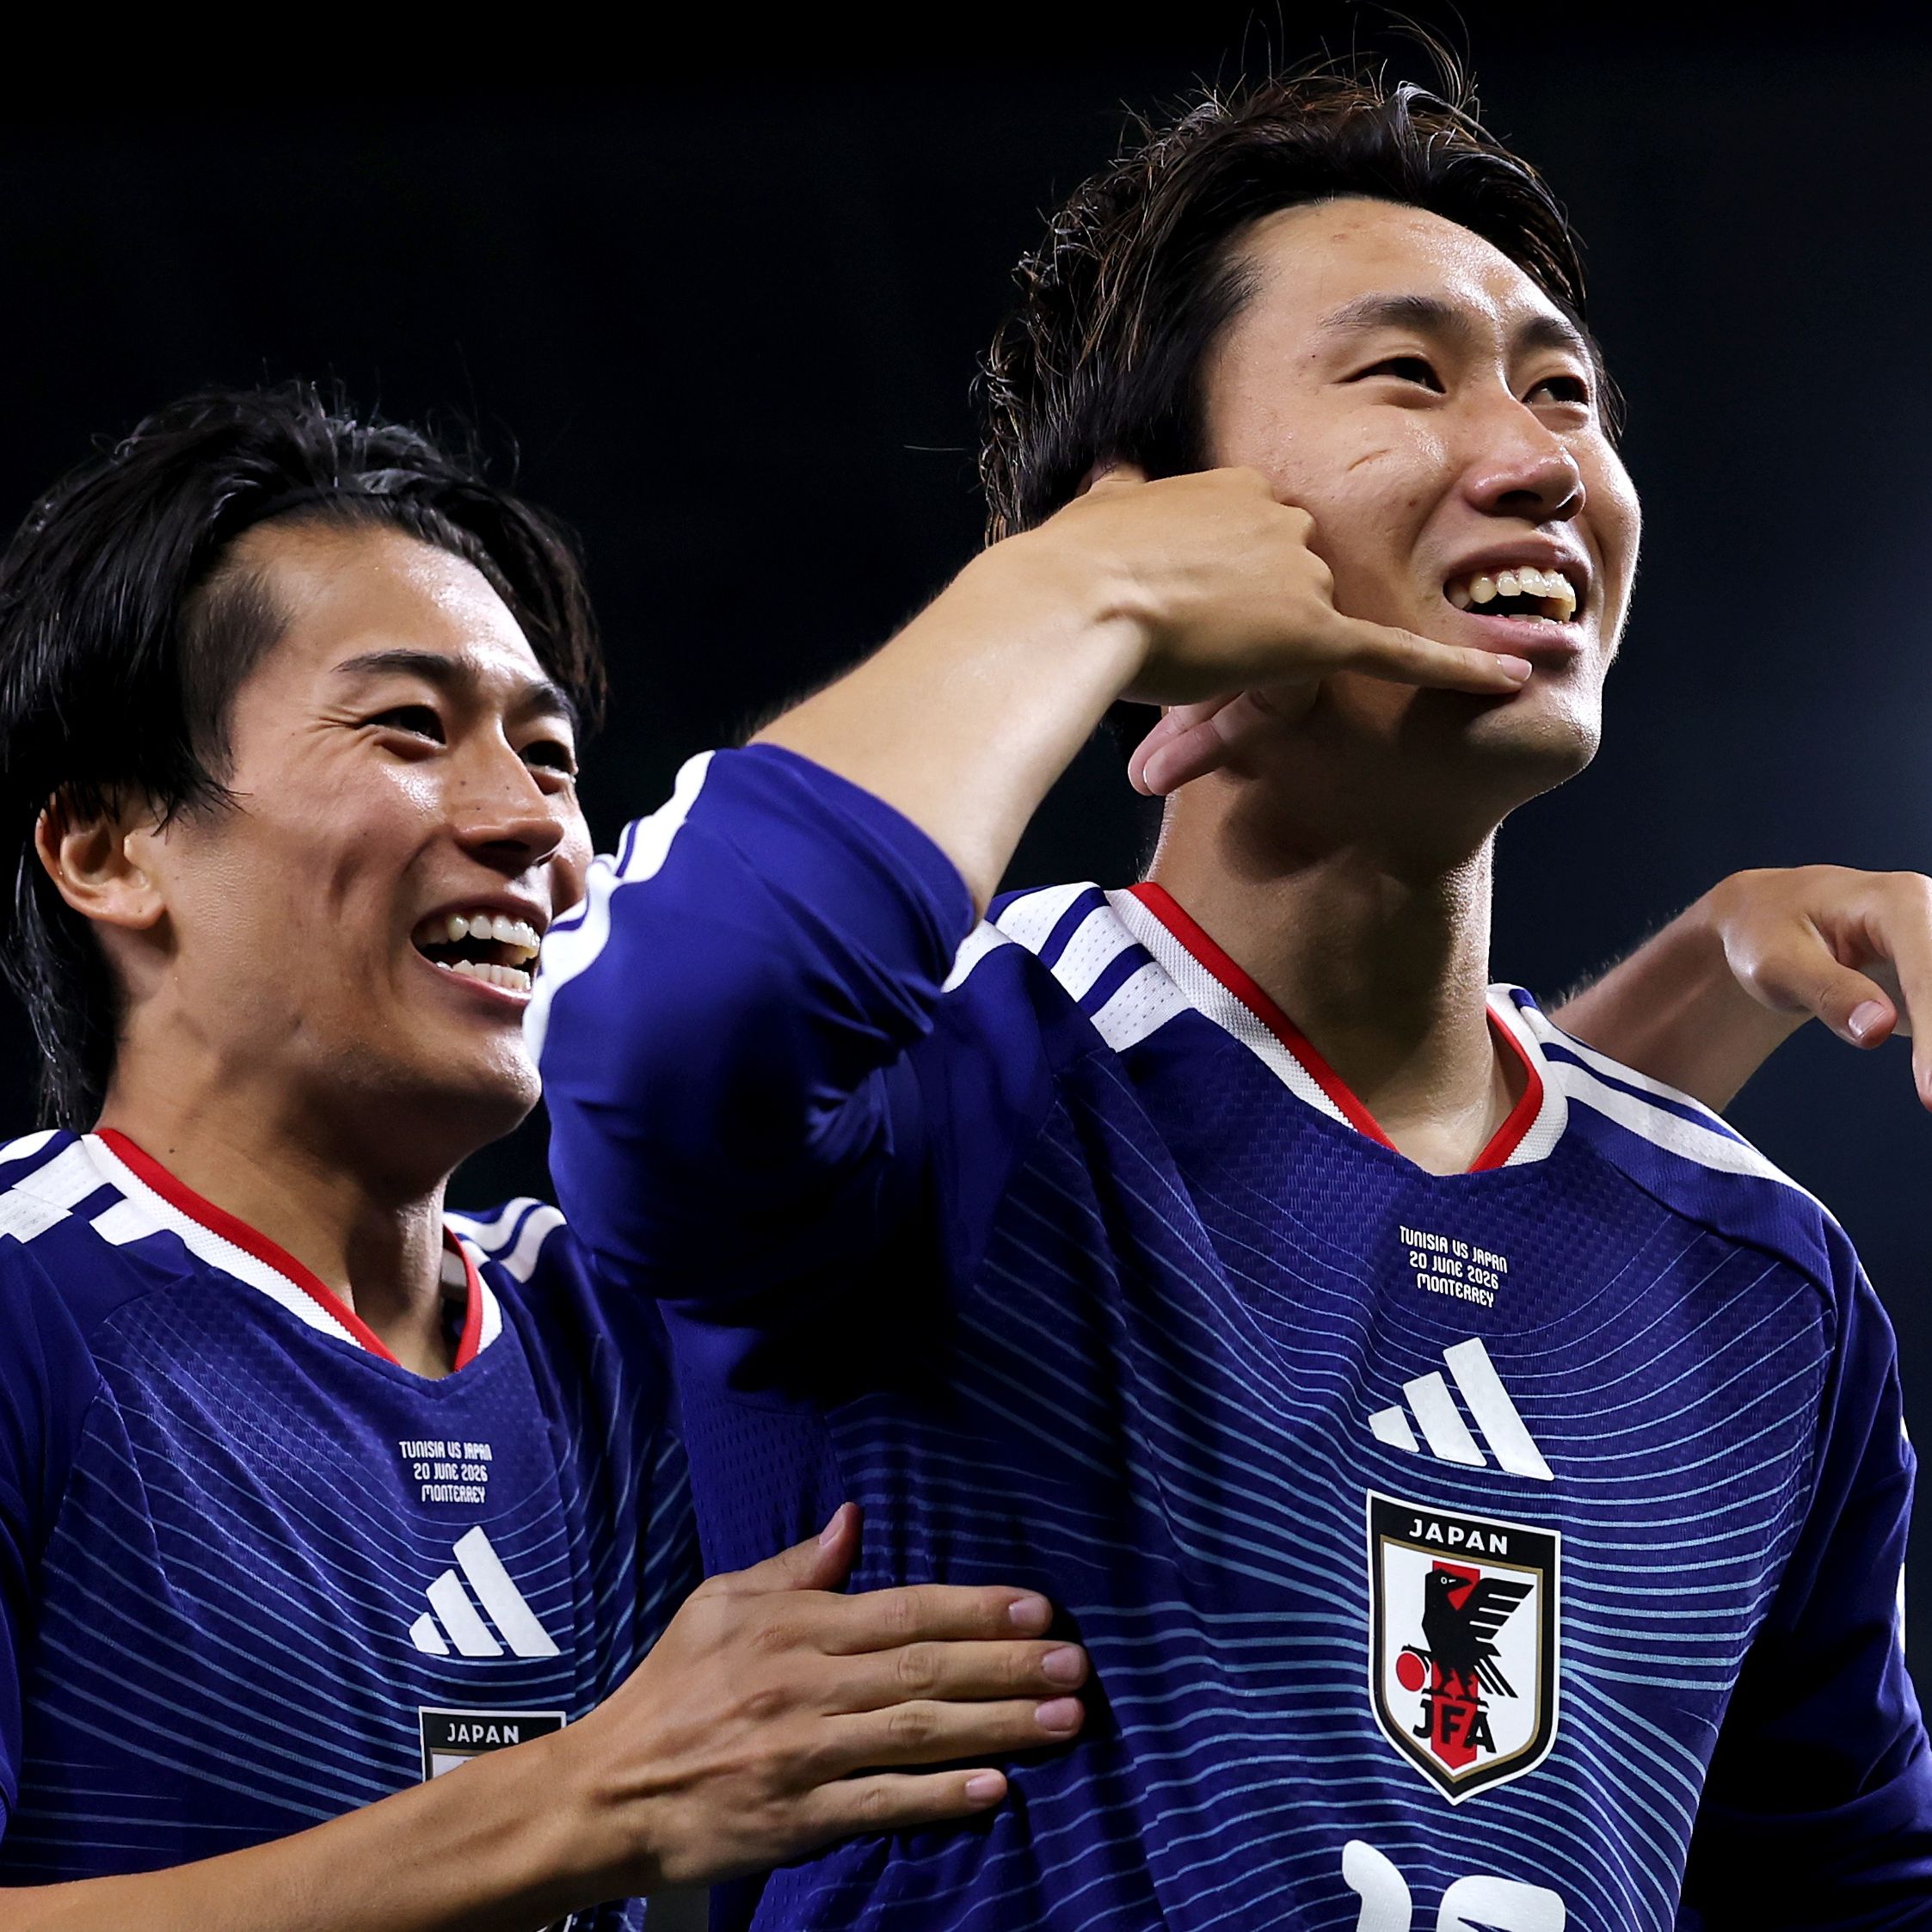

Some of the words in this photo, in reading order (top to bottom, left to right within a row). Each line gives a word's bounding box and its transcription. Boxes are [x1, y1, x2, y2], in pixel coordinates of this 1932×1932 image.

[1400, 1225, 1448, 1253] TUNISIA
[1472, 1246, 1507, 1273] JAPAN
[1409, 1251, 1427, 1268] 20
[1431, 1255, 1462, 1277] JUNE
[1467, 1264, 1498, 1289] 2026
[1417, 1272, 1493, 1307] MONTERREY
[398, 1440, 445, 1458] TUNISIA
[463, 1443, 492, 1461] JAPAN
[413, 1462, 429, 1480] 20
[434, 1462, 458, 1480] JUNE
[460, 1463, 488, 1481] 2026
[421, 1485, 485, 1503] MONTERREY
[1408, 1518, 1507, 1554] JAPAN
[446, 1722, 519, 1744] JAPAN
[1412, 1700, 1497, 1753] JFA
